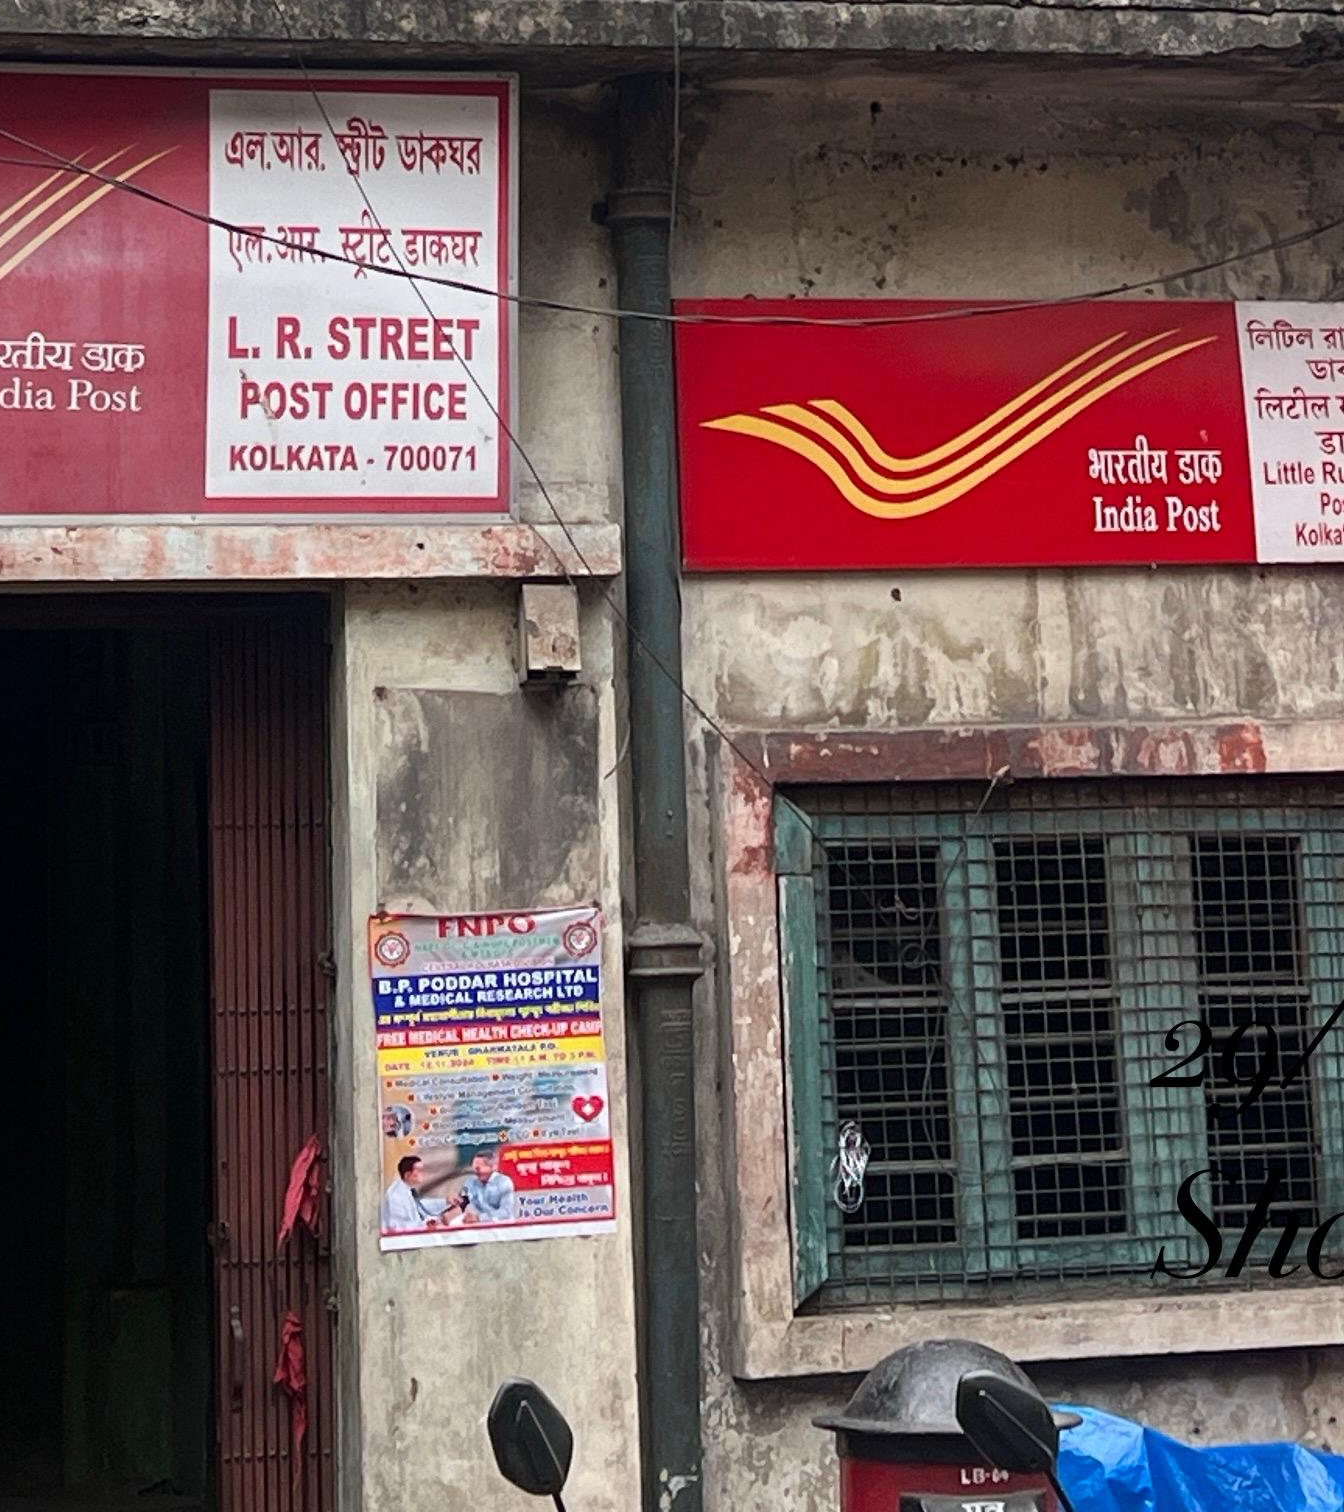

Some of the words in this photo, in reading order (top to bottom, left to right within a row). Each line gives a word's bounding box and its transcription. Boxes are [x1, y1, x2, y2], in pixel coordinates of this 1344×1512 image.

[397, 129, 483, 175] ডাকঘর
[401, 229, 482, 267] डाकघर
[228, 317, 262, 361] L.
[276, 317, 314, 361] R.
[326, 315, 480, 362] STREET
[80, 342, 145, 373] डाक
[66, 378, 142, 412] Post
[240, 381, 334, 422] POST
[343, 381, 468, 422] OFFICE
[1254, 386, 1331, 420] लिटील
[229, 444, 360, 473] KOLKATA
[384, 444, 477, 473] 700071
[1088, 434, 1168, 485] भारतीय
[1174, 449, 1222, 485] डाक
[1263, 462, 1315, 486] Little
[1092, 495, 1159, 532] India
[1164, 496, 1222, 532] Post
[409, 991, 473, 1007] MEDICAL
[477, 987, 553, 1002] RESEARCH
[556, 984, 584, 999] LTD
[418, 973, 499, 992] PODDAR
[503, 968, 598, 987] HOSPITAL
[377, 1031, 406, 1048] FREE
[409, 1028, 460, 1045] MEDICAL
[462, 1024, 507, 1041] HEALTH
[510, 1022, 568, 1038] CHECK-UP
